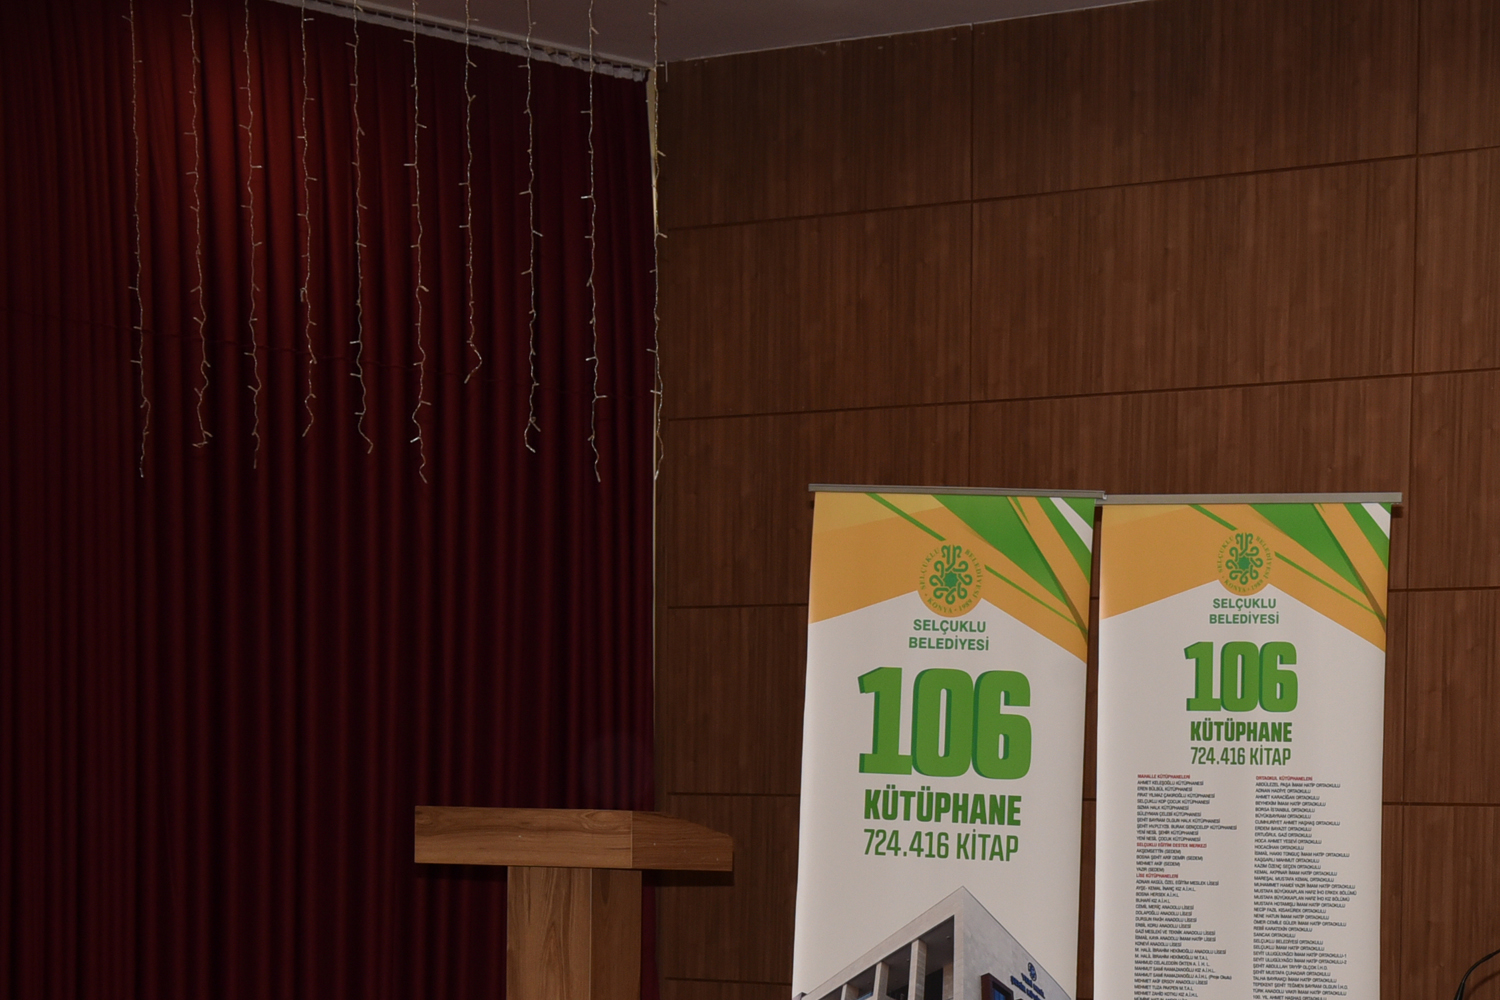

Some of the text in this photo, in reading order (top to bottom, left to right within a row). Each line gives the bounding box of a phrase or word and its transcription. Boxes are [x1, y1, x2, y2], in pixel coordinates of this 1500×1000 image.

[1212, 598, 1277, 611] SELÇUKLU
[913, 619, 986, 634] SELÇUKLU
[1209, 613, 1280, 625] BELEDİYESİ
[909, 635, 989, 651] BELEDİYESİ
[1184, 641, 1298, 713] 106
[858, 666, 1032, 780] 106
[1190, 717, 1293, 743] KÜTÜPHANE
[1190, 745, 1292, 766] 724.416 KİTAP
[864, 784, 1022, 826] KÜTÜPHANE
[864, 829, 1019, 862] 724.416 KİTAP
